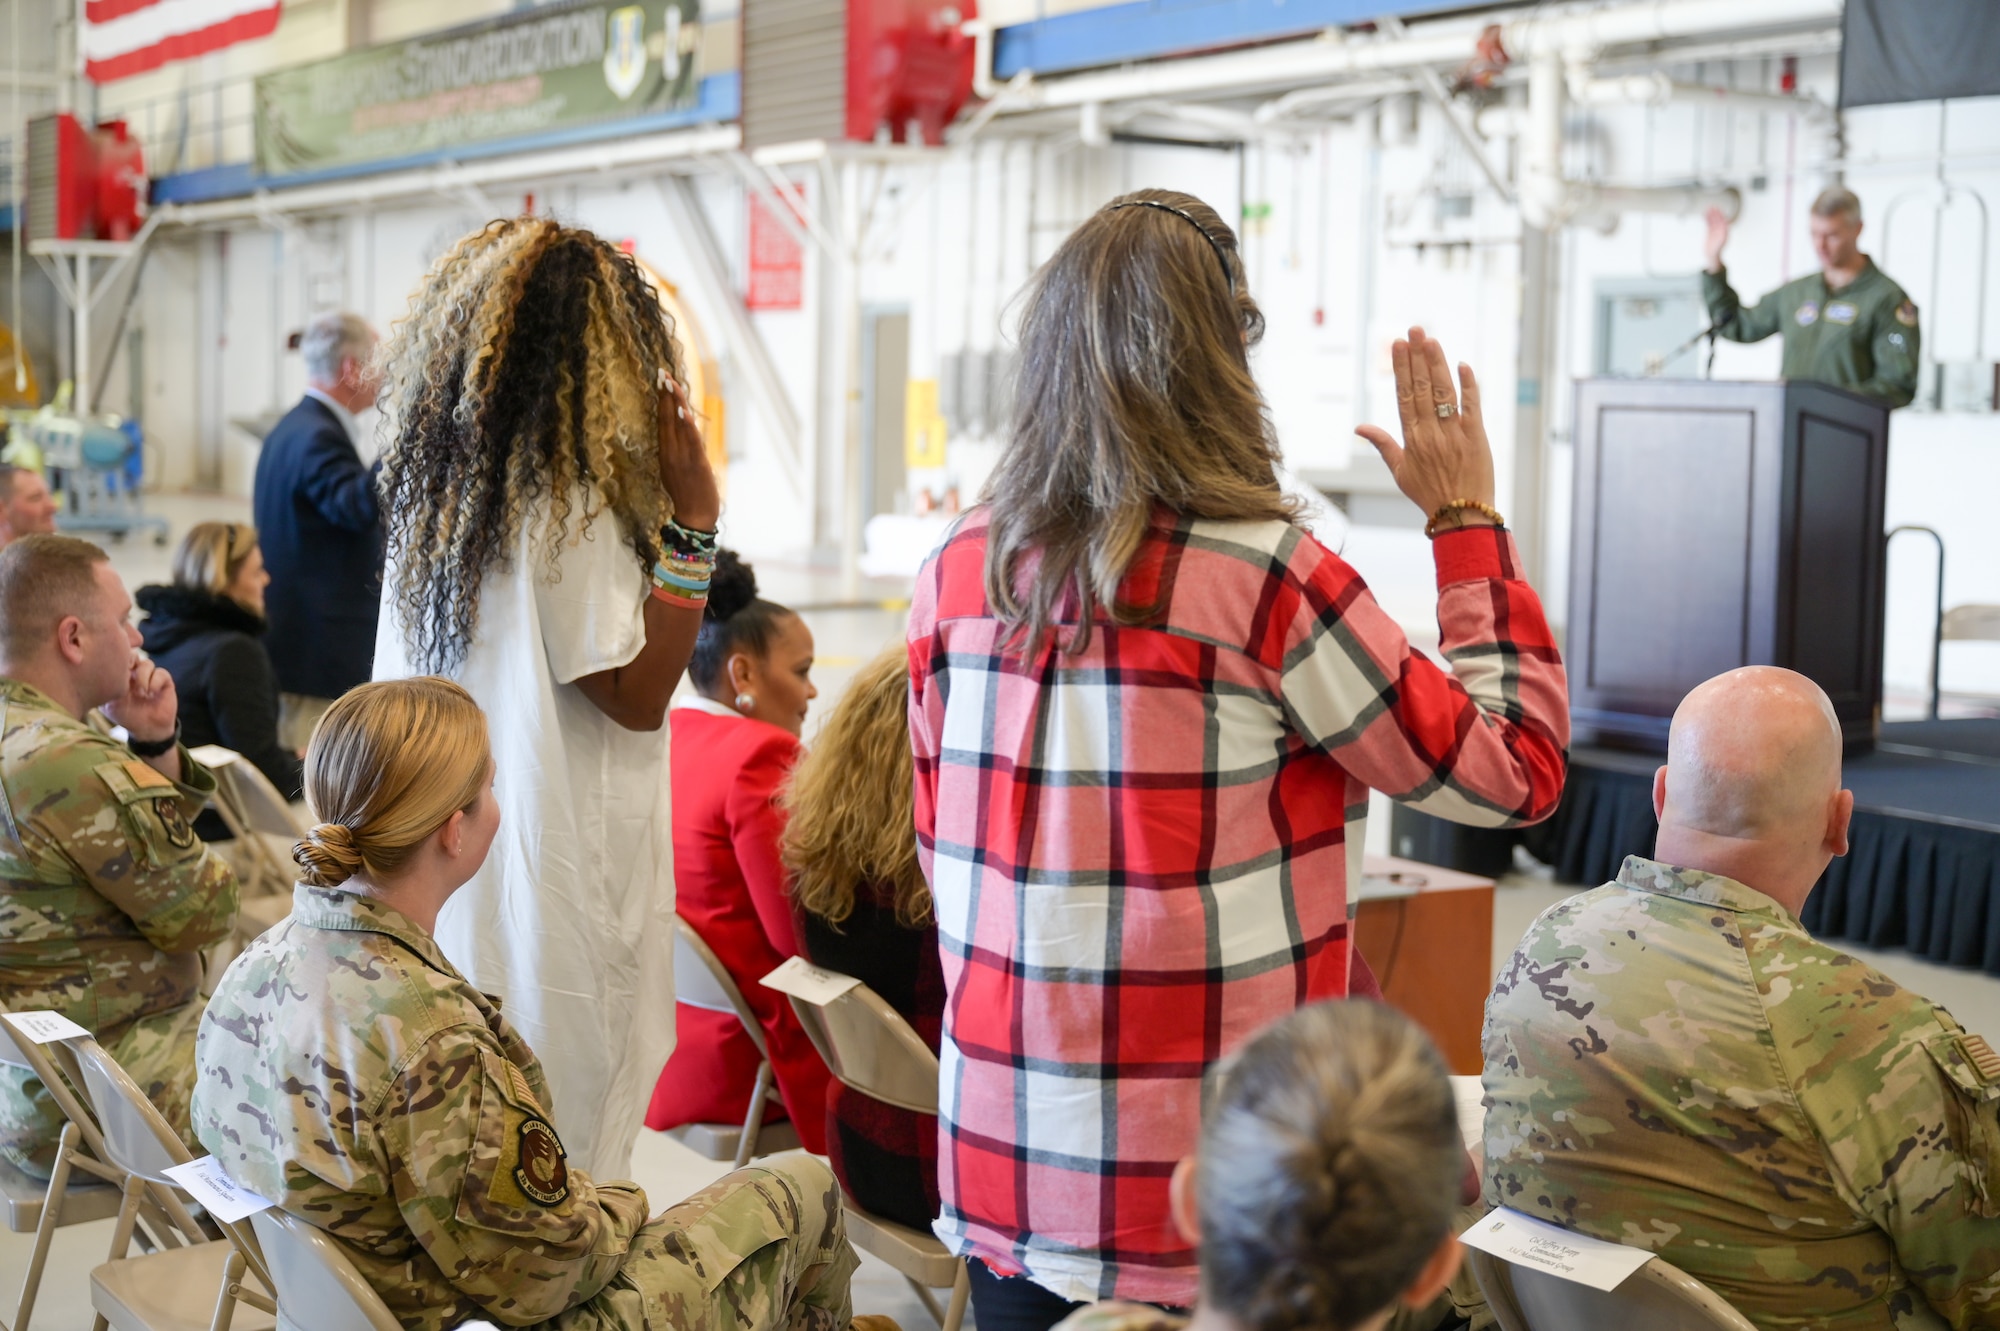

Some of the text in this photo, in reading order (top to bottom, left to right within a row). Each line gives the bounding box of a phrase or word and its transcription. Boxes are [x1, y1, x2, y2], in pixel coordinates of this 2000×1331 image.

[403, 7, 606, 96] STANDARDIZATION
[527, 1184, 557, 1201] MAINTENANCE
[1521, 1251, 1556, 1265] Maintenance
